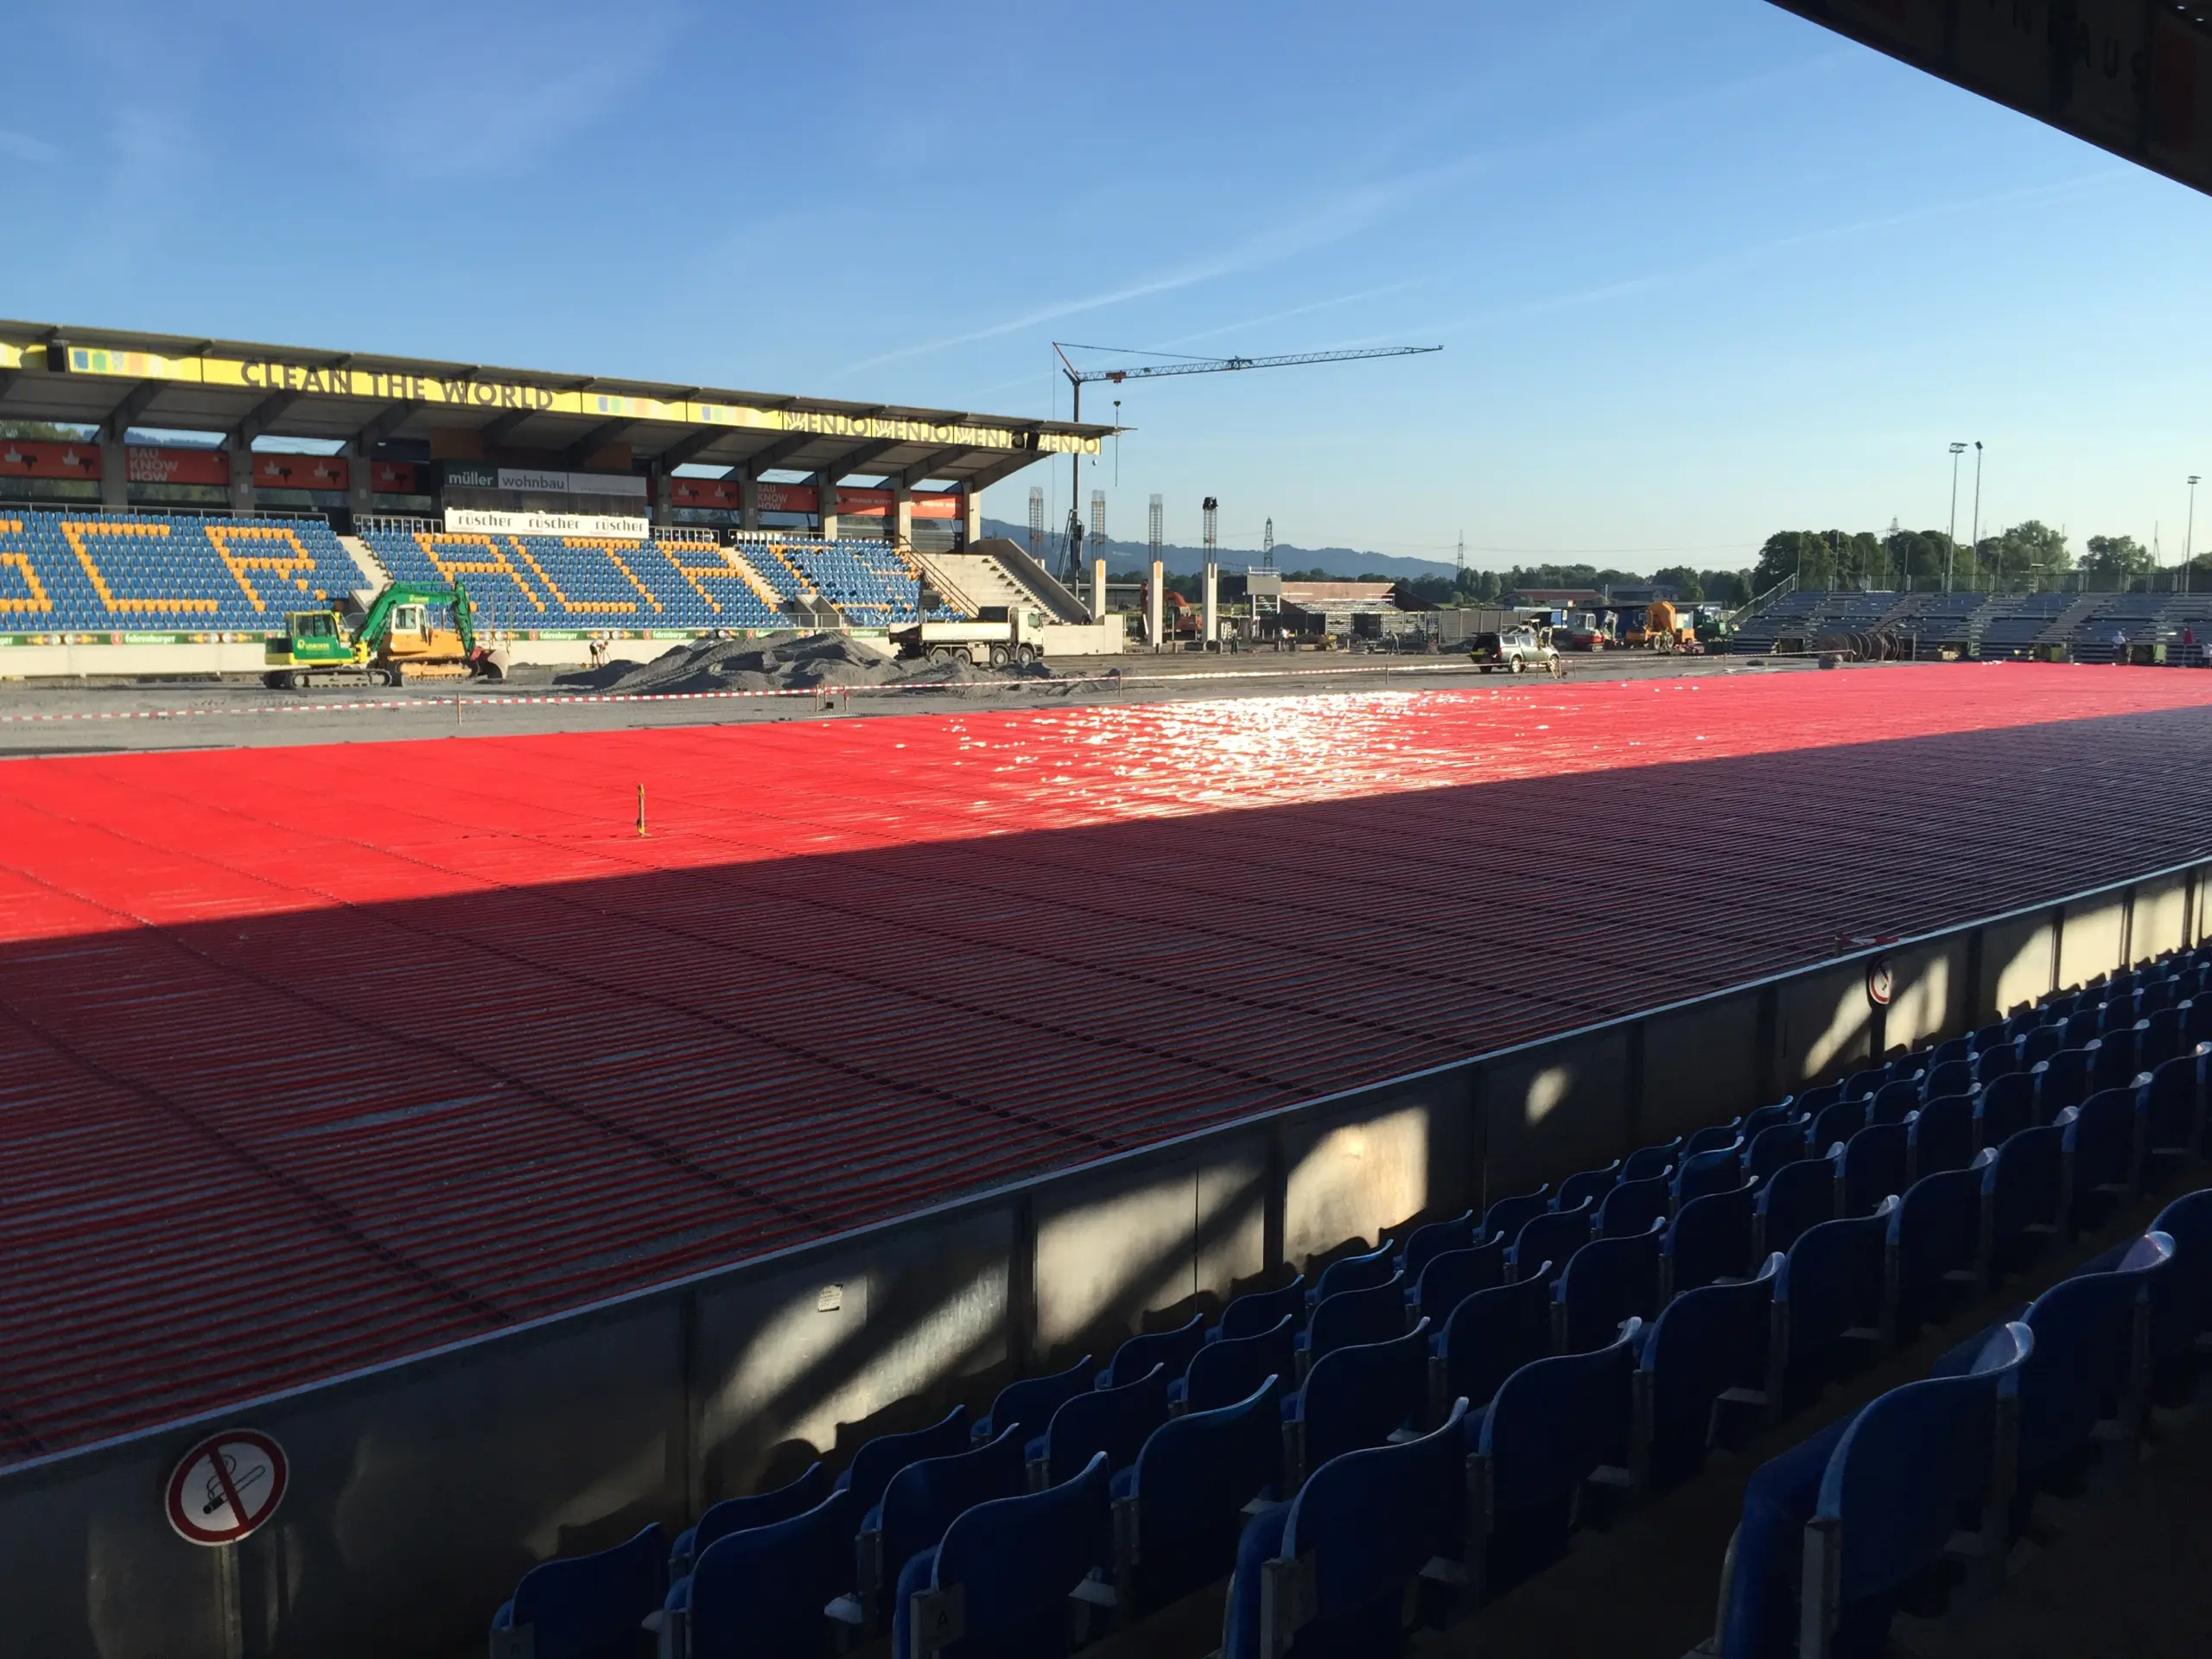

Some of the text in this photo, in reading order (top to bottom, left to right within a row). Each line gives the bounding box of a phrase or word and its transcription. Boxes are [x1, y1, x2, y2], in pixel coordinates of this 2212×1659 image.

[241, 359, 554, 410] CLEAN THE WORLD
[807, 411, 867, 437] ENJO
[893, 420, 951, 443] ENJO
[974, 427, 1024, 448] ENJ
[1050, 434, 1098, 454] ENJO
[130, 448, 159, 459] BAU
[130, 459, 178, 472] KNOW
[130, 471, 168, 481] HOW
[448, 472, 493, 486] müller
[502, 475, 564, 490] wohnbau
[758, 493, 788, 503] KNOW
[458, 512, 513, 527] rüscher
[529, 515, 581, 530] rüscher
[595, 518, 644, 532] rüscher
[937, 1610, 950, 1630] A
